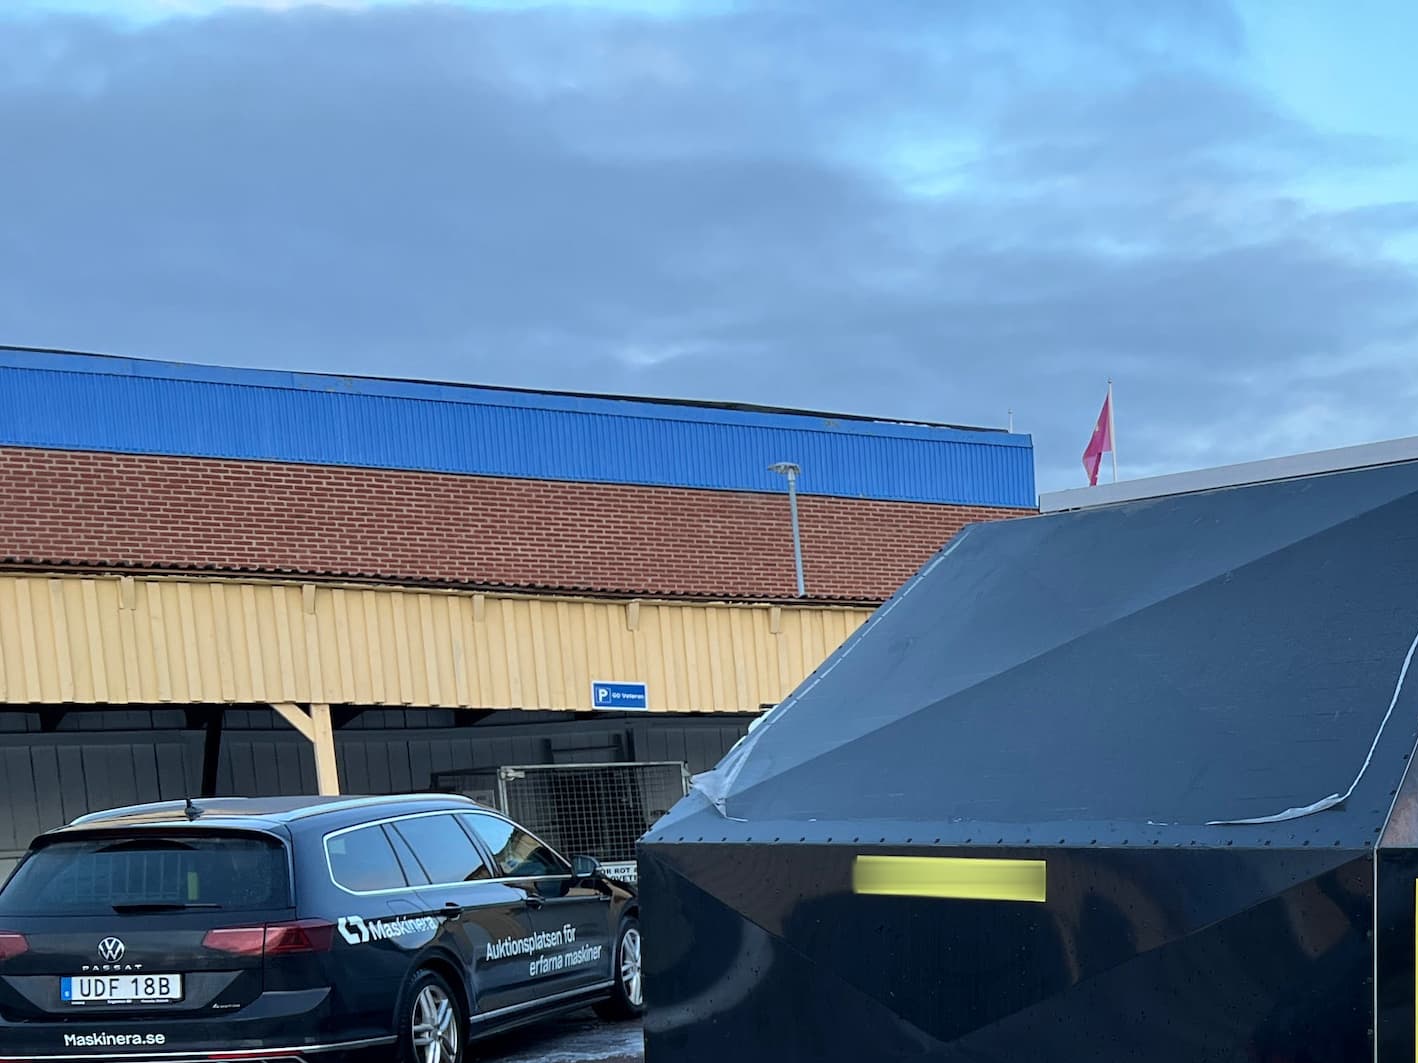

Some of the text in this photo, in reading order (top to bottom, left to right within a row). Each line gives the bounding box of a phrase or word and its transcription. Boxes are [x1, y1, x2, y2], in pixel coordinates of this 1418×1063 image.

[369, 916, 437, 941] Maskinera
[486, 923, 576, 962] Auktionsplatsen för
[529, 943, 602, 977] erfarna maskiner
[80, 978, 170, 997] UDF 18B
[64, 1032, 166, 1047] Maskinera.se
